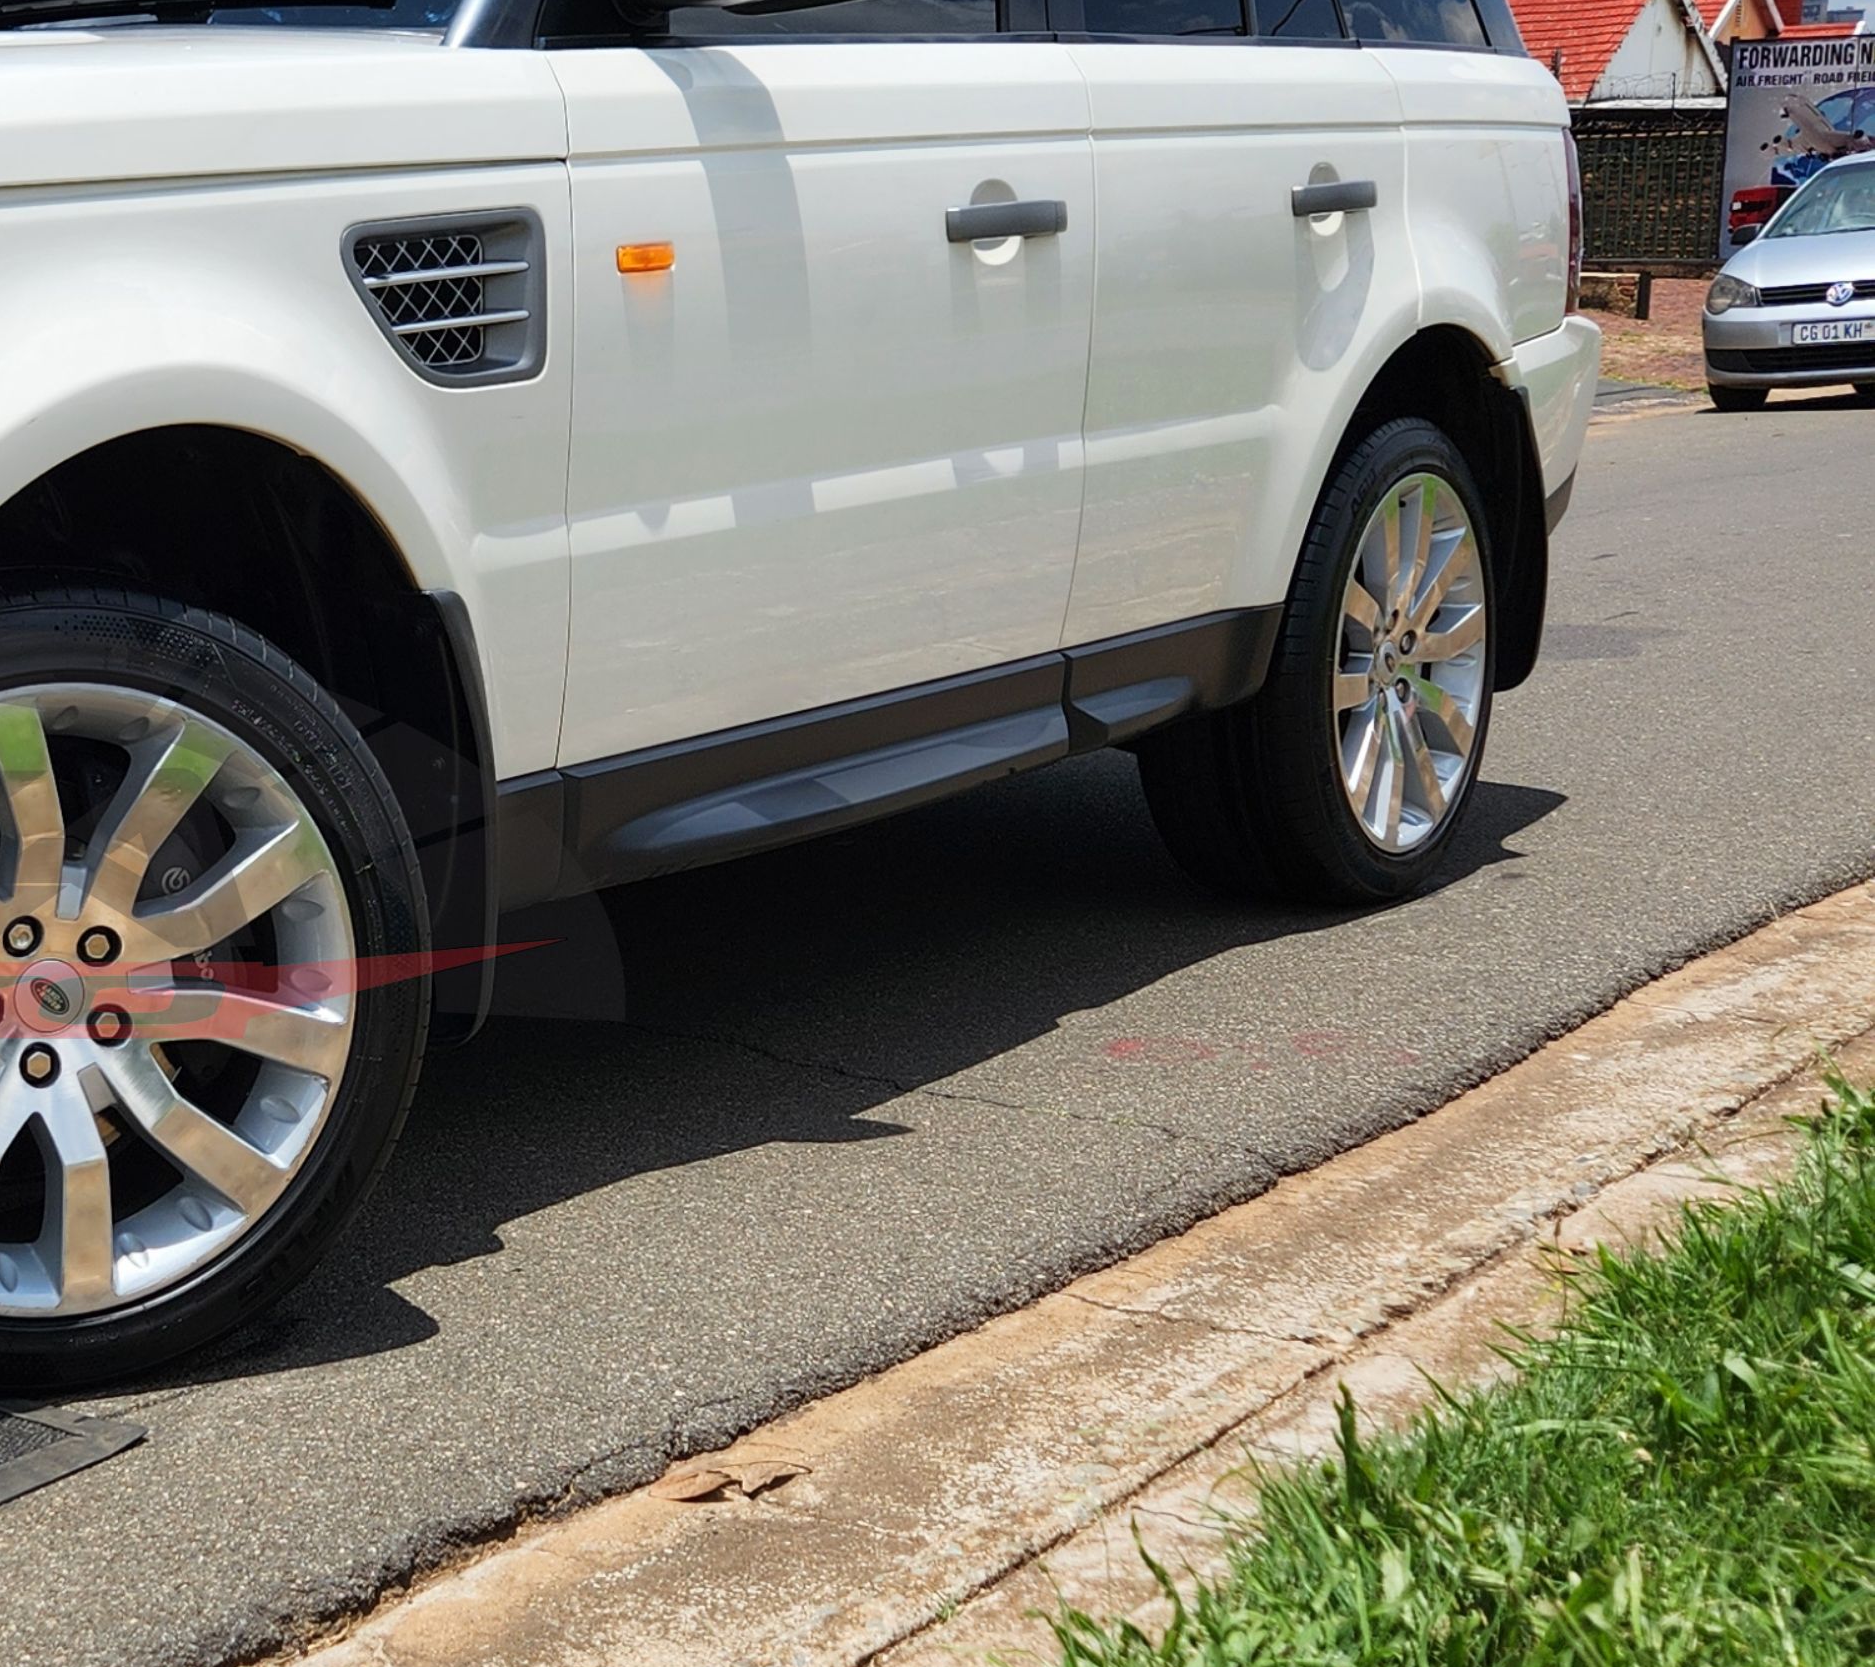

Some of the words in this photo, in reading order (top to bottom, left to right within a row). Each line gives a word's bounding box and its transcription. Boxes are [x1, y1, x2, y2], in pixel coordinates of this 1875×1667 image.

[1738, 43, 1855, 70] FORWARDING
[1736, 75, 1755, 86] AIR
[1758, 74, 1804, 86] FREIGHT
[1813, 72, 1844, 84] ROAD
